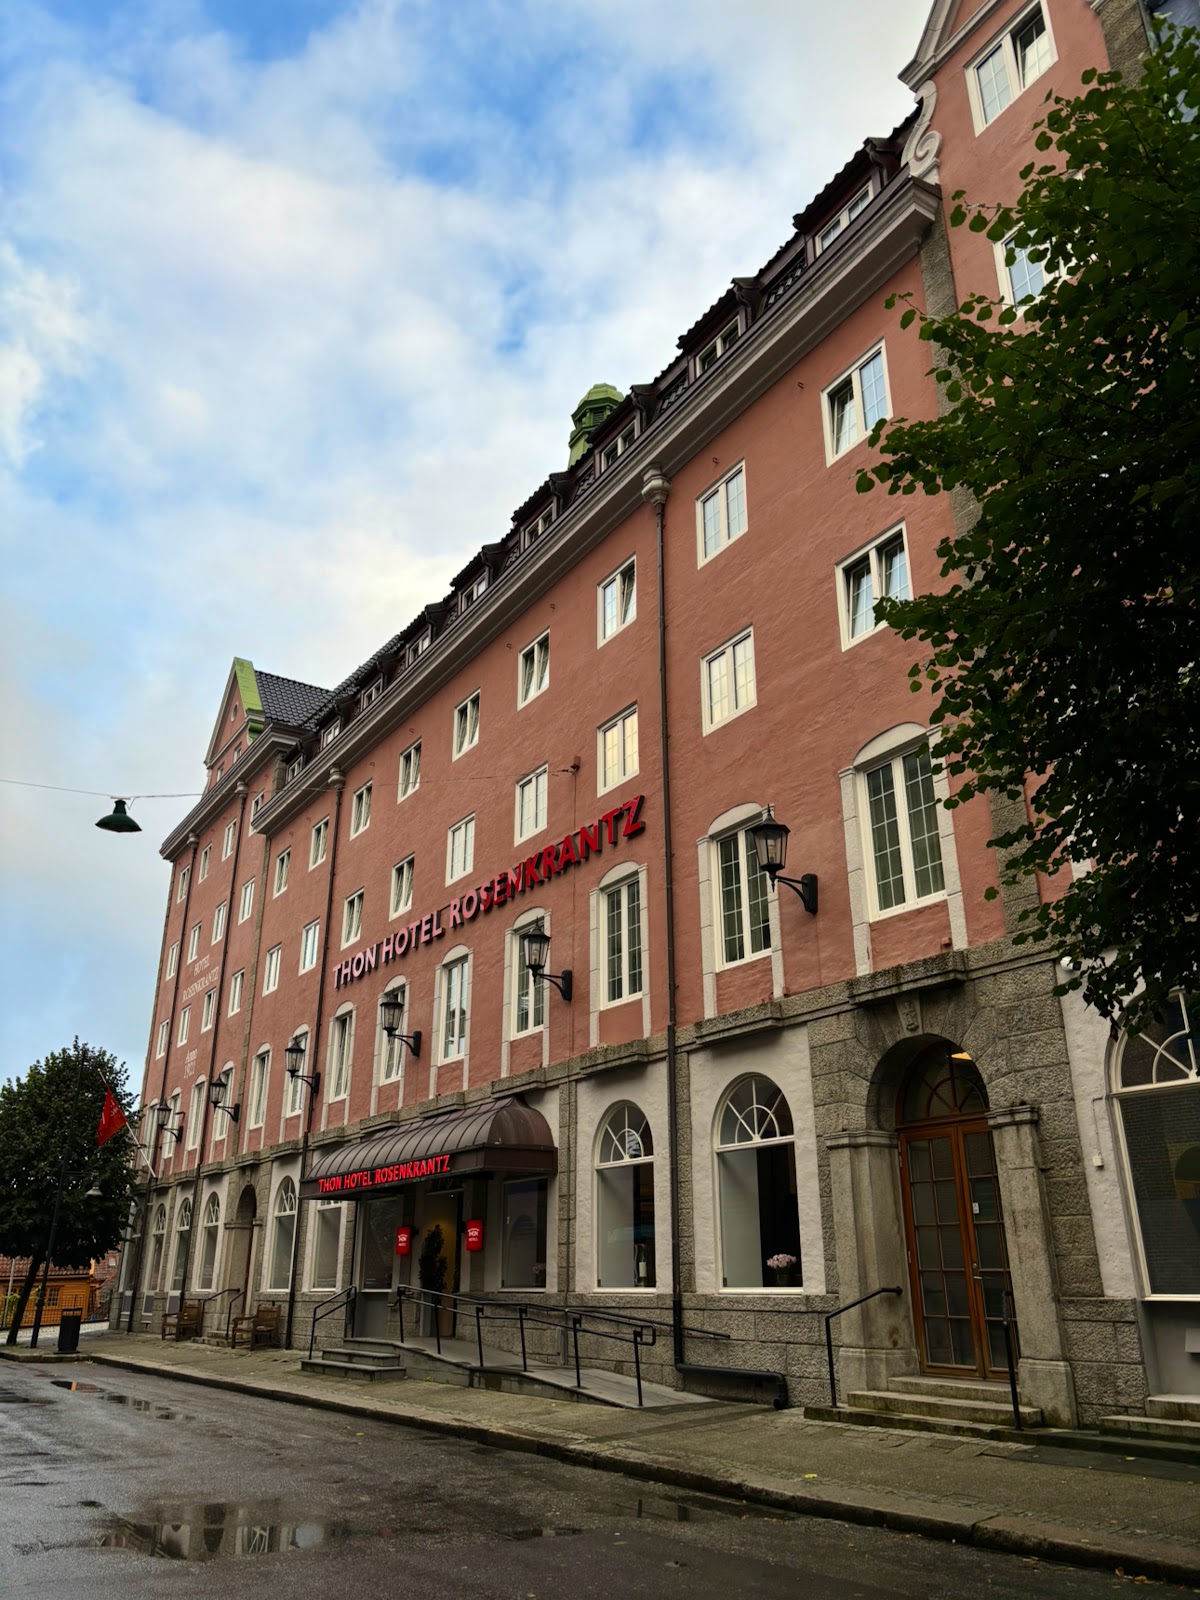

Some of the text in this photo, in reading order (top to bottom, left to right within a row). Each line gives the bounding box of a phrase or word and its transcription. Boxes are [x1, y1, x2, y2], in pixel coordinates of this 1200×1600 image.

[332, 794, 646, 991] THON HOTEL ROSENKRANTZ
[194, 955, 209, 976] HOTEL
[318, 1154, 450, 1194] THON HOTEL ROSENKRANTZ
